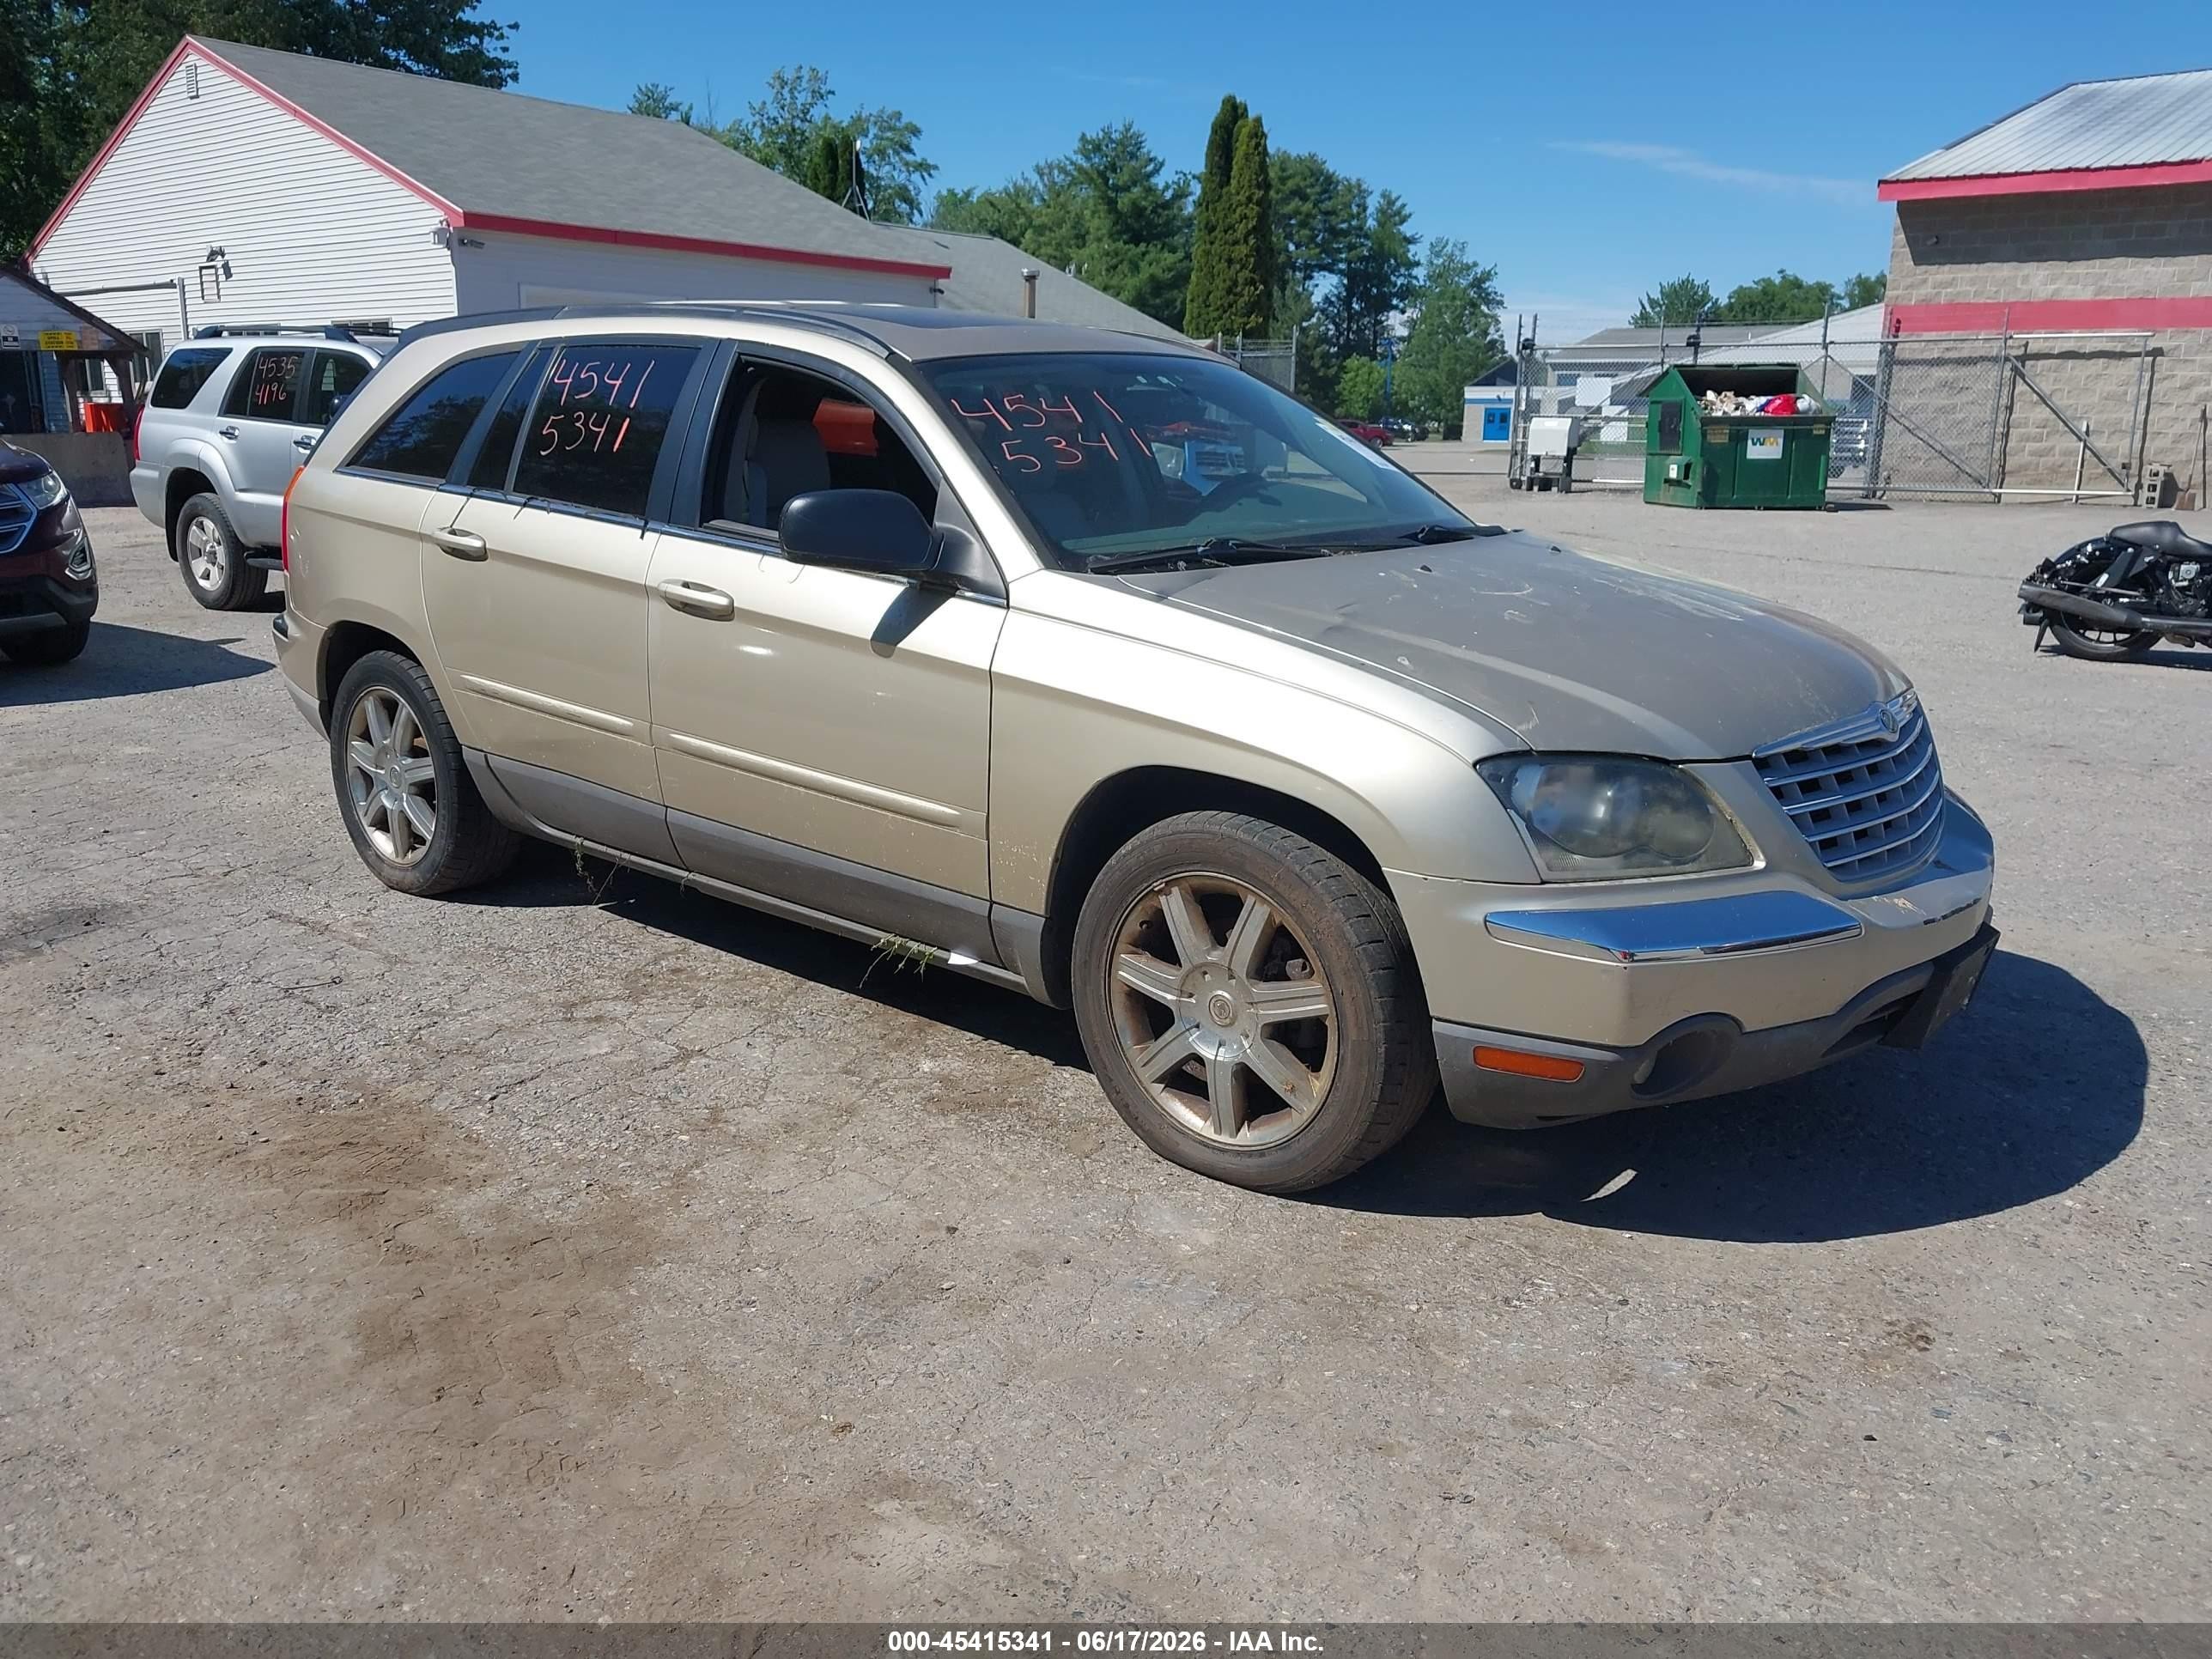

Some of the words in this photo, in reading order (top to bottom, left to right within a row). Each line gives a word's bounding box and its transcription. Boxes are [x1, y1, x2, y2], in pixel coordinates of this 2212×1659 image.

[258, 356, 298, 379] 4535
[554, 358, 655, 409] 4541
[255, 382, 287, 405] 4196
[951, 391, 1123, 430] 4541
[540, 411, 629, 456] 5341
[1000, 428, 1152, 472] 5341
